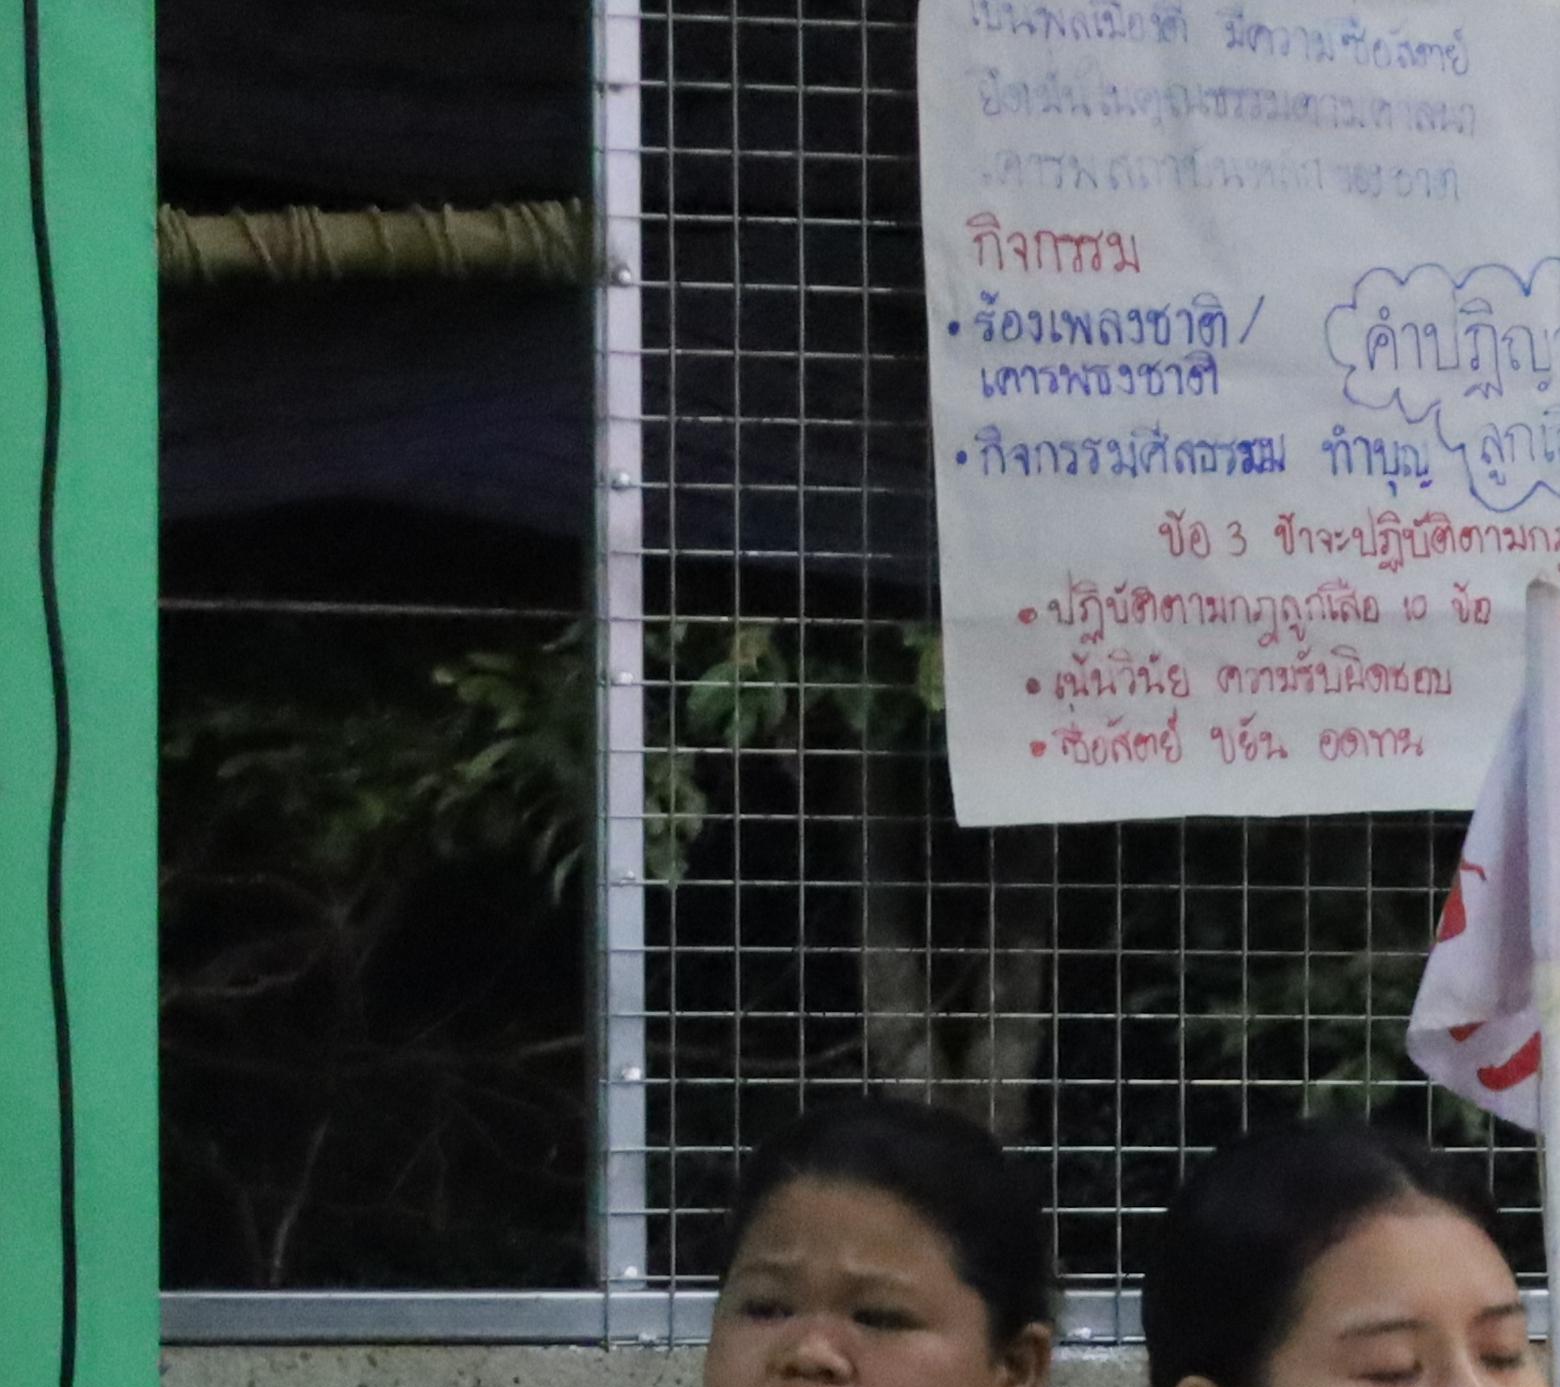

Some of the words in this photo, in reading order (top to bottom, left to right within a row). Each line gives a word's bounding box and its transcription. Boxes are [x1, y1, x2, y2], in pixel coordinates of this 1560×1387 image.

[966, 212, 1142, 273] กิจกรรม
[981, 351, 1220, 399] เคารพธงชาติ
[1319, 724, 1425, 763] อดทน
